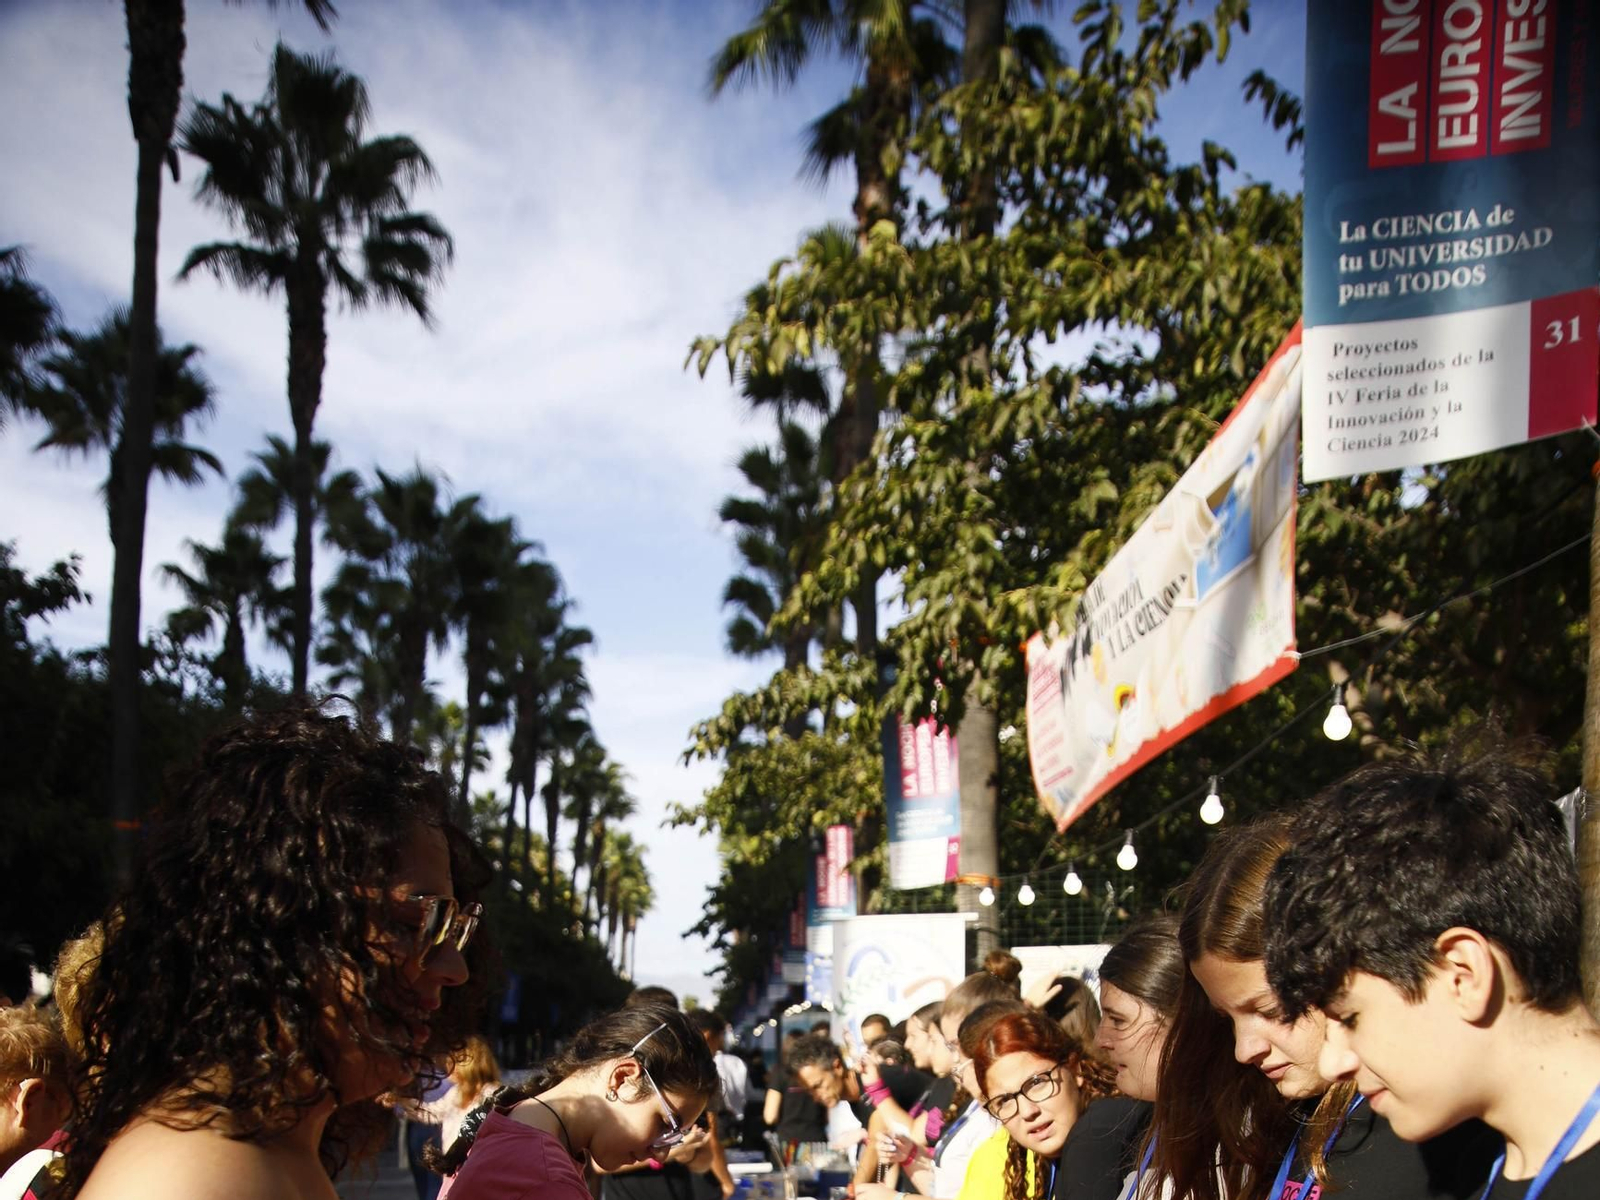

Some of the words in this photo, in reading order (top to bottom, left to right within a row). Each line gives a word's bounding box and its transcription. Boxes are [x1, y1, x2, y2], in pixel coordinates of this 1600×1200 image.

[1377, 81, 1418, 155] LA
[1339, 220, 1367, 244] La
[1372, 208, 1482, 239] CIENCIA
[1486, 204, 1515, 227] de
[1339, 254, 1363, 274] tu
[1369, 226, 1553, 270] UNIVERSIDAD
[1338, 280, 1391, 307] para
[1395, 264, 1486, 295] TODOS
[1332, 337, 1419, 359] Proyectos
[1543, 315, 1583, 350] 31
[1326, 356, 1446, 381] seleccionados
[1452, 352, 1473, 367] de
[1478, 349, 1495, 363] la
[1328, 390, 1349, 406] IV
[1355, 385, 1402, 405] Feria
[1407, 382, 1429, 397] de
[1434, 379, 1449, 394] la
[1328, 405, 1426, 430] Innovación
[1431, 405, 1440, 421] y
[1447, 400, 1463, 414] la
[1327, 432, 1393, 452] Ciencia
[1399, 425, 1440, 444] 2024
